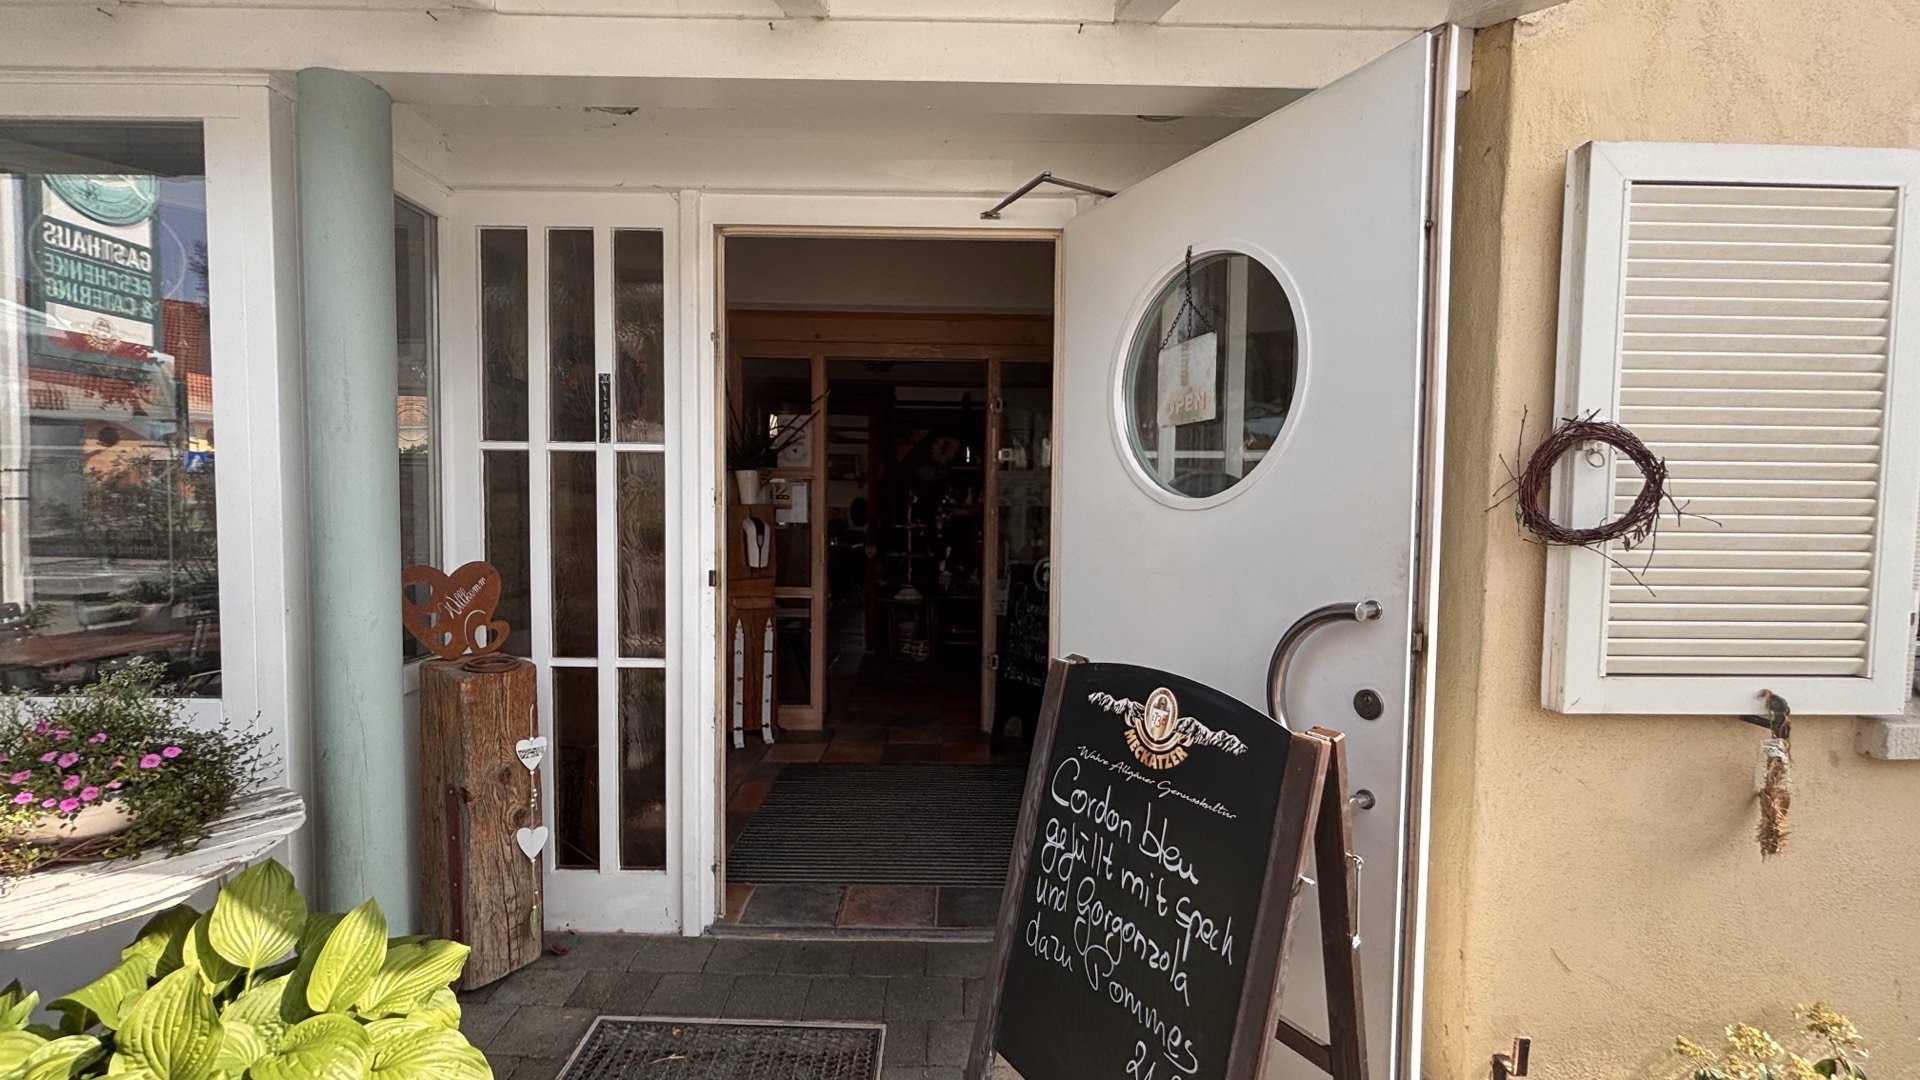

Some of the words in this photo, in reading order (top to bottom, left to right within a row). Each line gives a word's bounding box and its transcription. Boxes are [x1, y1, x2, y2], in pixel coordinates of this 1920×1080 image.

[1166, 391, 1207, 415] OPEN
[1077, 745, 1110, 766] Wahre
[1123, 728, 1189, 770] MECKATZER
[1051, 756, 1133, 844] Cordon
[1139, 801, 1199, 886] bleu
[1121, 867, 1168, 917] mit
[1036, 875, 1071, 913] und
[1073, 876, 1190, 1007] Gorgonzola
[1026, 911, 1074, 973] dazu
[1084, 944, 1199, 1074] Pommes
